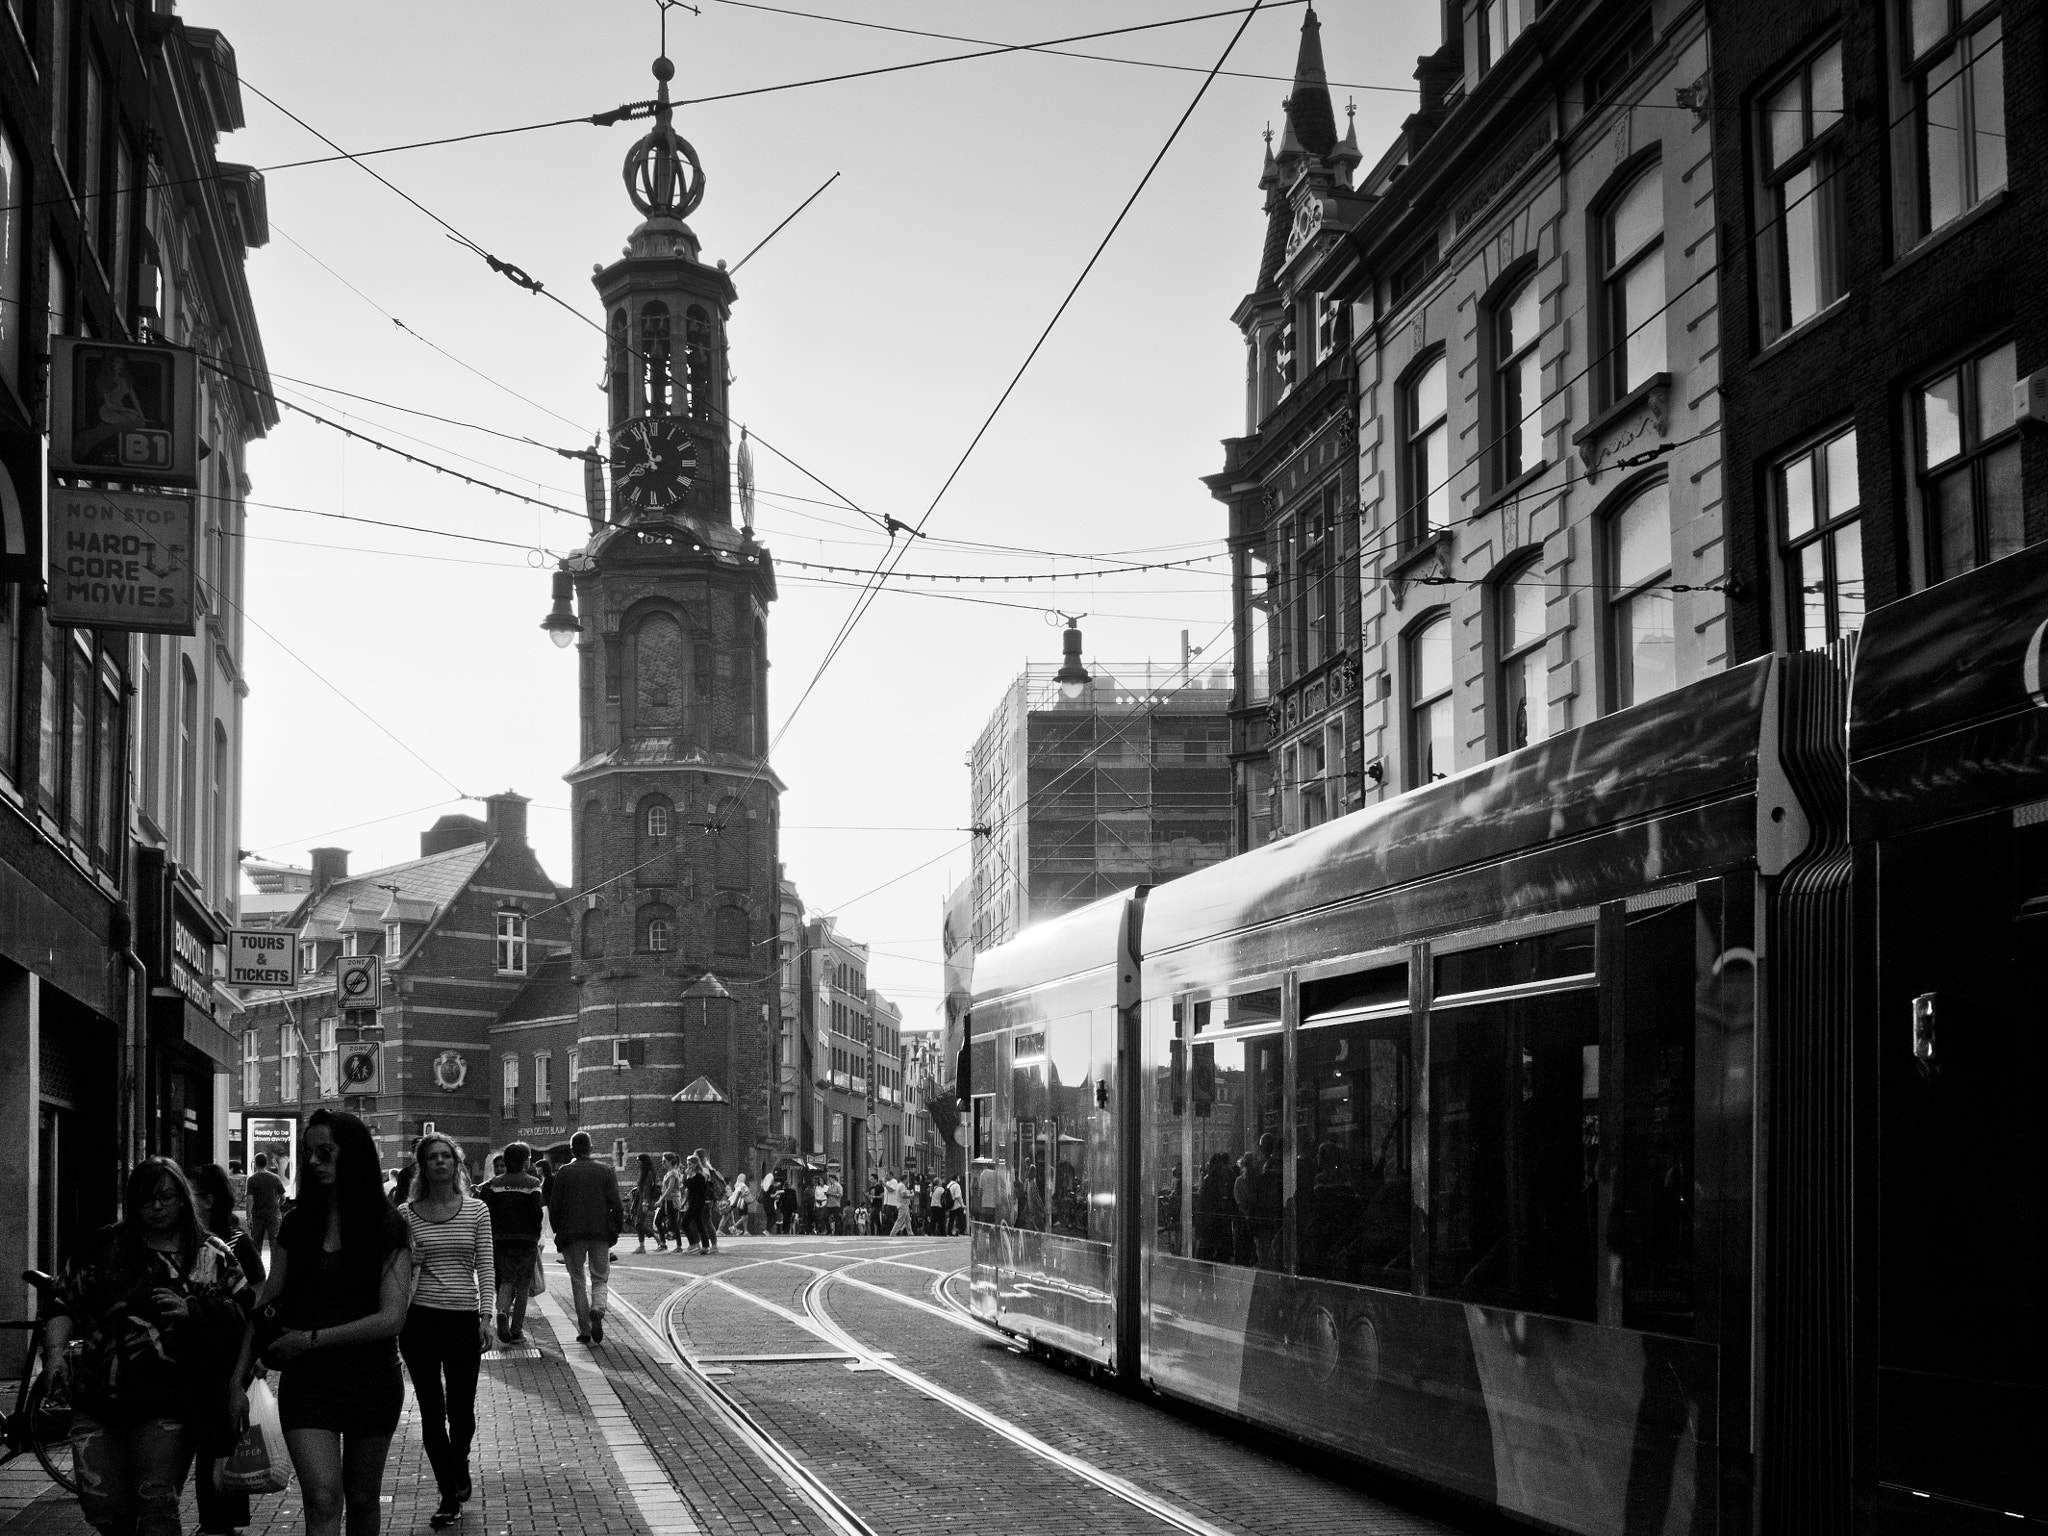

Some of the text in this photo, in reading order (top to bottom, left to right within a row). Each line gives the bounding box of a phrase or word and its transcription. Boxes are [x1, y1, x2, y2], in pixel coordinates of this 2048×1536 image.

[125, 433, 166, 463] B1
[67, 503, 176, 525] NON STOP
[67, 531, 140, 556] HARD
[67, 556, 140, 582] CORE
[67, 582, 175, 608] MOVIES
[240, 935, 285, 950] TOURS
[256, 952, 268, 966] &
[234, 968, 289, 982] TICKETS
